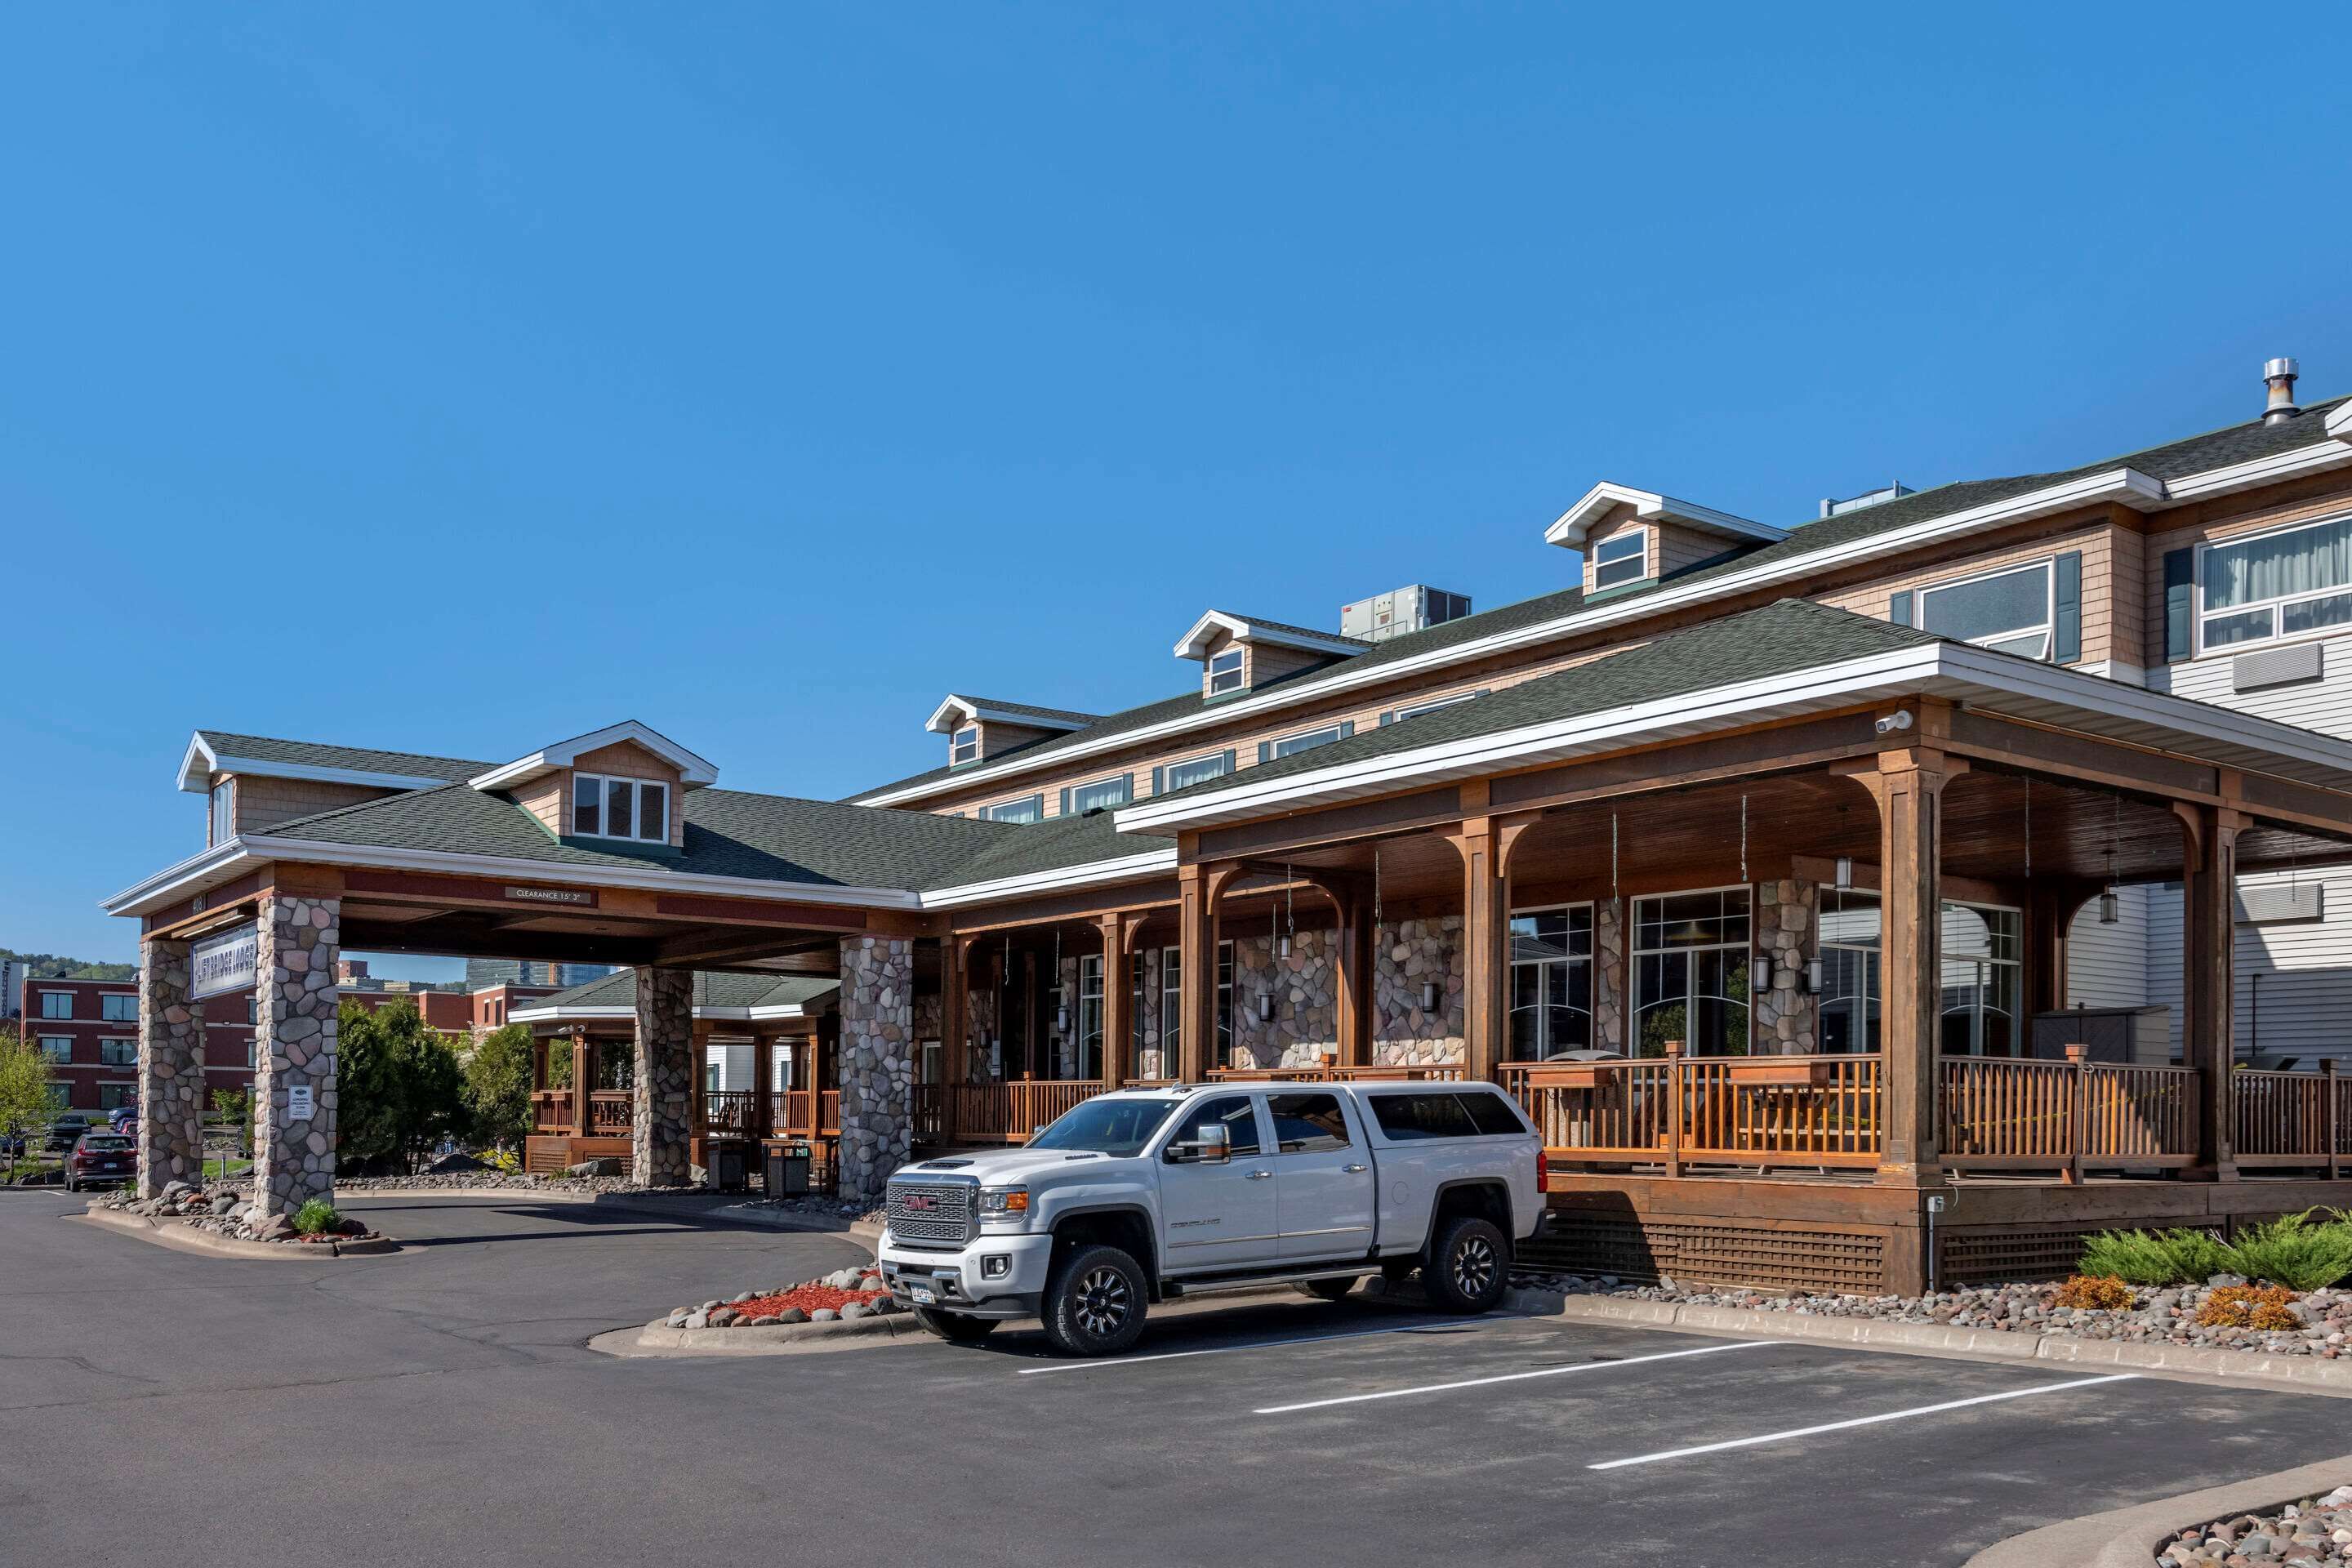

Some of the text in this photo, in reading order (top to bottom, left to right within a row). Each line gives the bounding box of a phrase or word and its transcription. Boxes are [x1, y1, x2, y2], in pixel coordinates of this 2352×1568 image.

[516, 889, 558, 899] CLEARANCE
[561, 892, 571, 900] 15'
[211, 950, 233, 980] BRIDGE
[233, 942, 255, 974] LODGE
[902, 1196, 938, 1211] GMC
